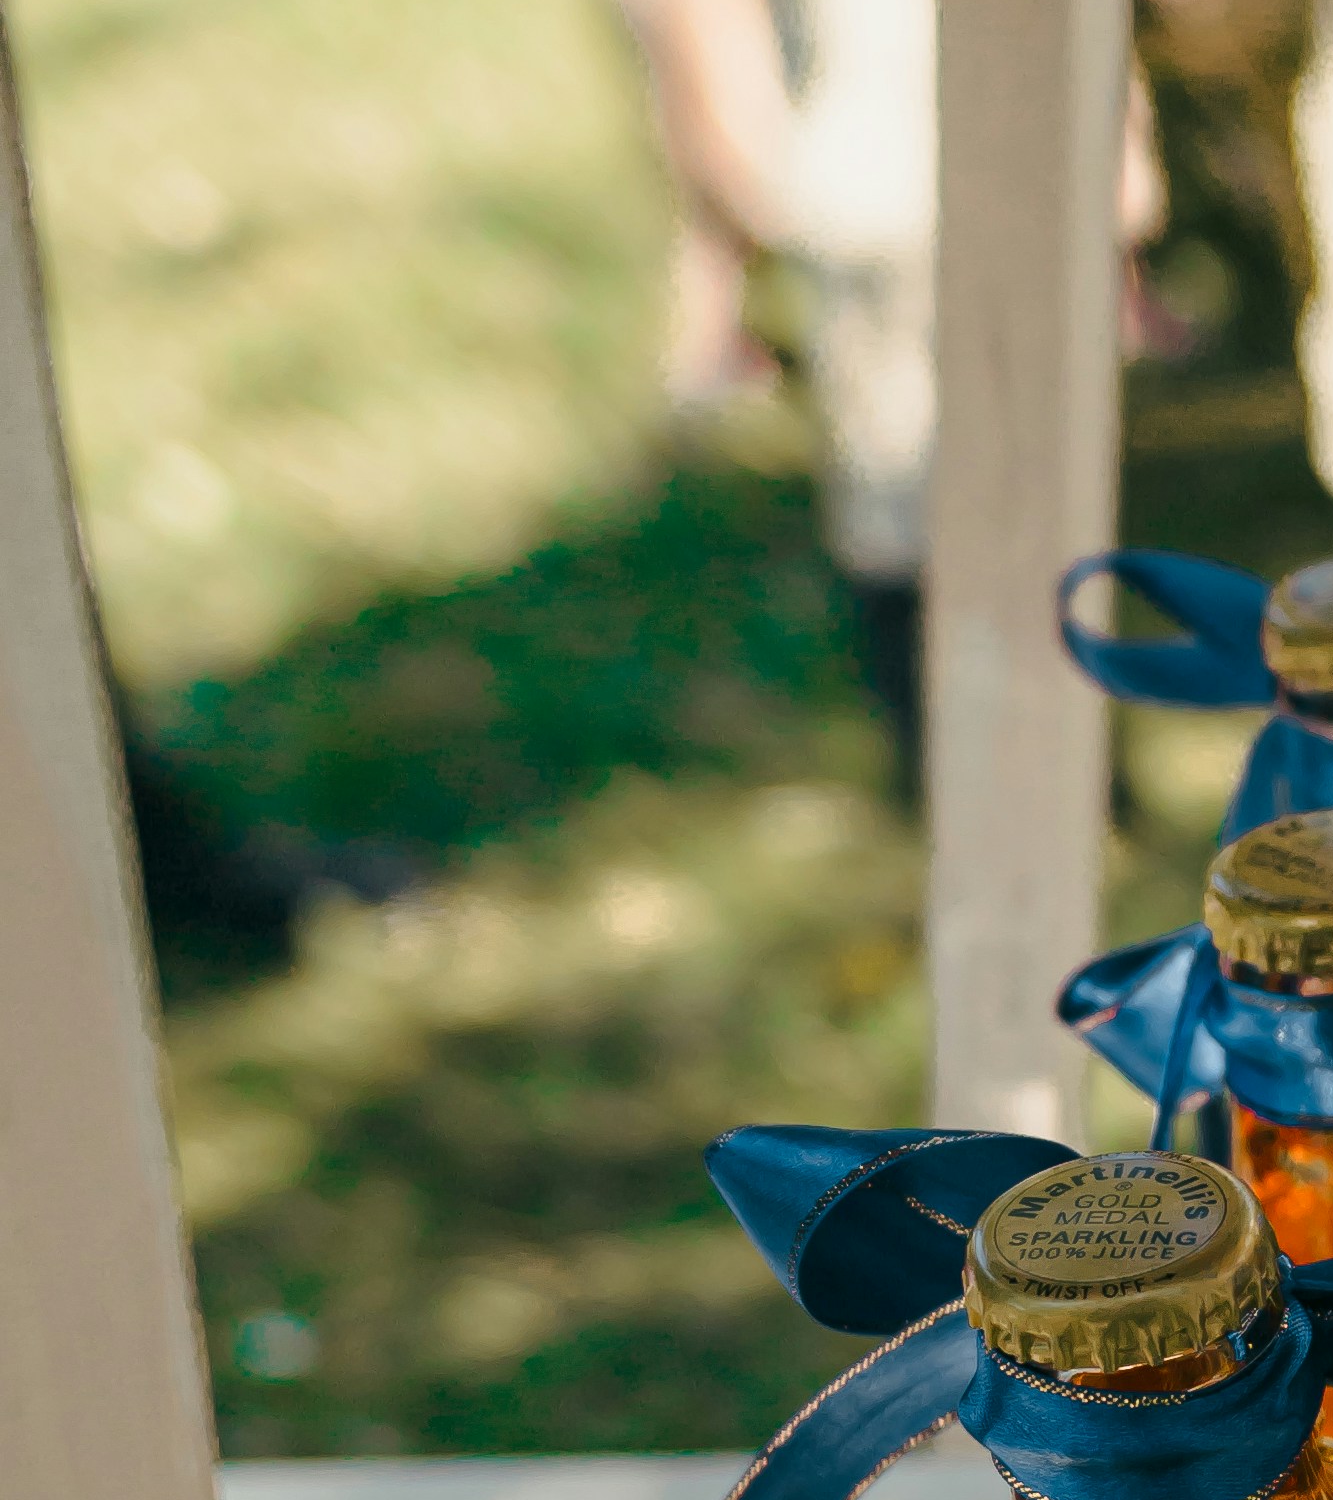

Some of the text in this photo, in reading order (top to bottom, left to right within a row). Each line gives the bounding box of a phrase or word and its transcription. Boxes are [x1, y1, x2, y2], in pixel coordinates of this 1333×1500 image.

[1007, 1162, 1218, 1221] Martinelli's
[1074, 1193, 1162, 1209] GOLD
[1053, 1210, 1170, 1225] MEDAL
[1008, 1229, 1198, 1247] SPARKLING
[1018, 1246, 1176, 1261] 100% JUICE
[1021, 1277, 1147, 1300] TWIST OFF
